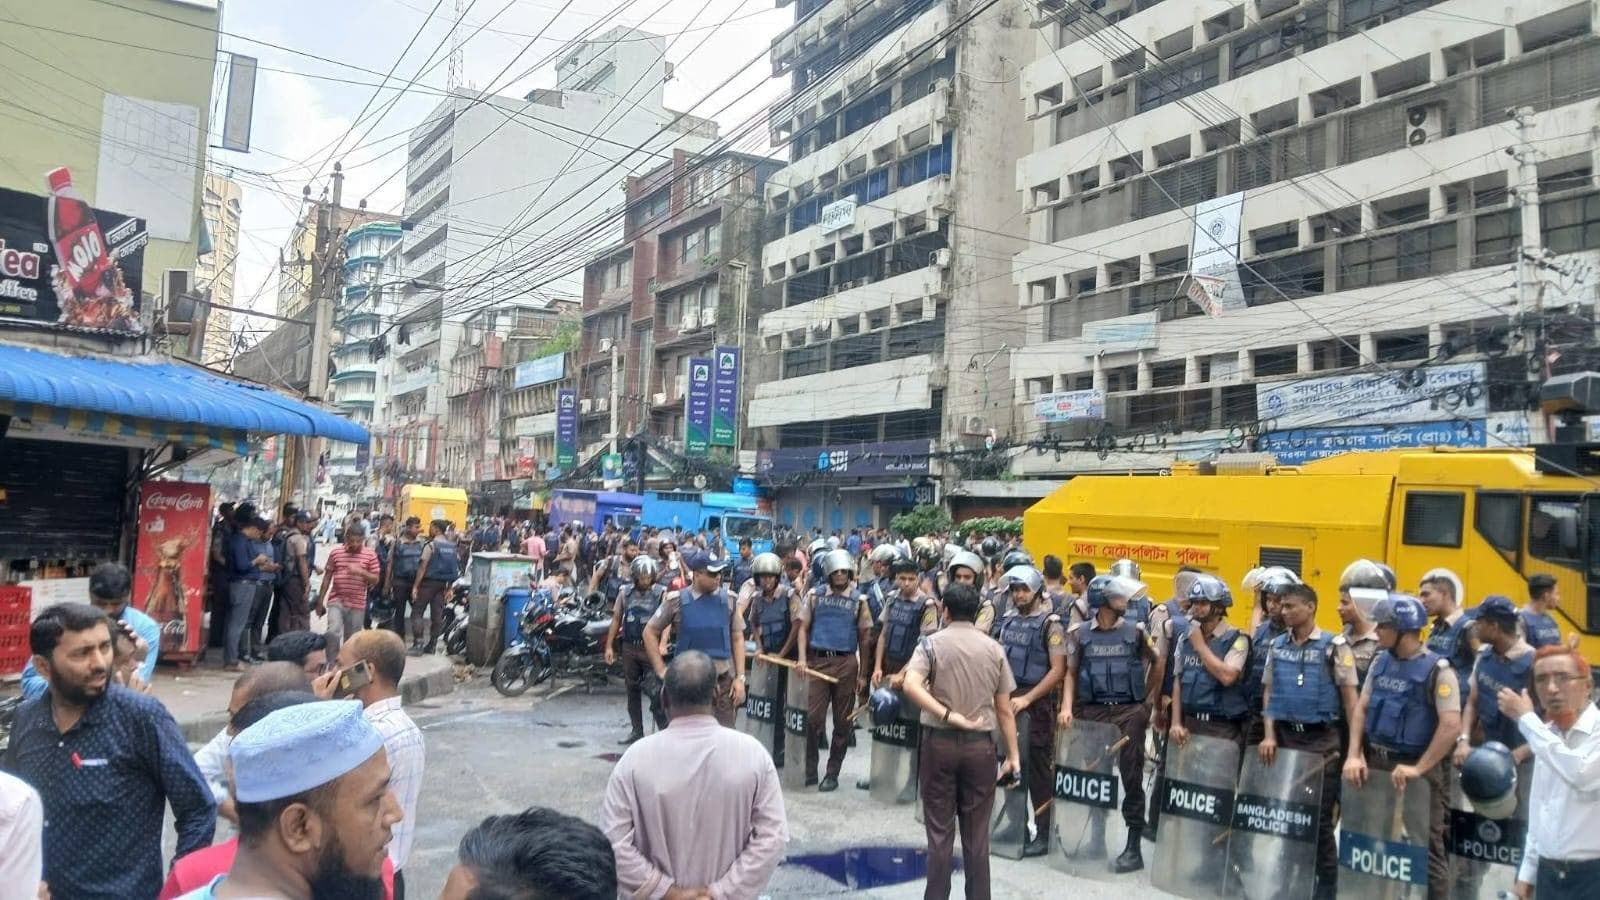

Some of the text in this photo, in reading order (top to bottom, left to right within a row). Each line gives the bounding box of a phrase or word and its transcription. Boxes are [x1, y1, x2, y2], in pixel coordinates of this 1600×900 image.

[0, 239, 40, 279] ea
[0, 279, 37, 301] offee
[830, 450, 849, 472] SBI
[914, 486, 931, 504] SBI
[1073, 542, 1210, 566] ঢাকা মেট্রোপলিটন পুলিশ
[818, 596, 852, 609] POLICE
[1093, 645, 1120, 655] POLICE
[1184, 656, 1202, 667] POL
[746, 698, 771, 719] OLICE
[1055, 771, 1111, 802] POLICE
[1169, 787, 1216, 814] POLICE
[1237, 802, 1312, 826] BANGLADESH
[1247, 817, 1288, 834] POLICE
[1463, 839, 1521, 865] POLICE
[1351, 847, 1412, 882] POLICE
